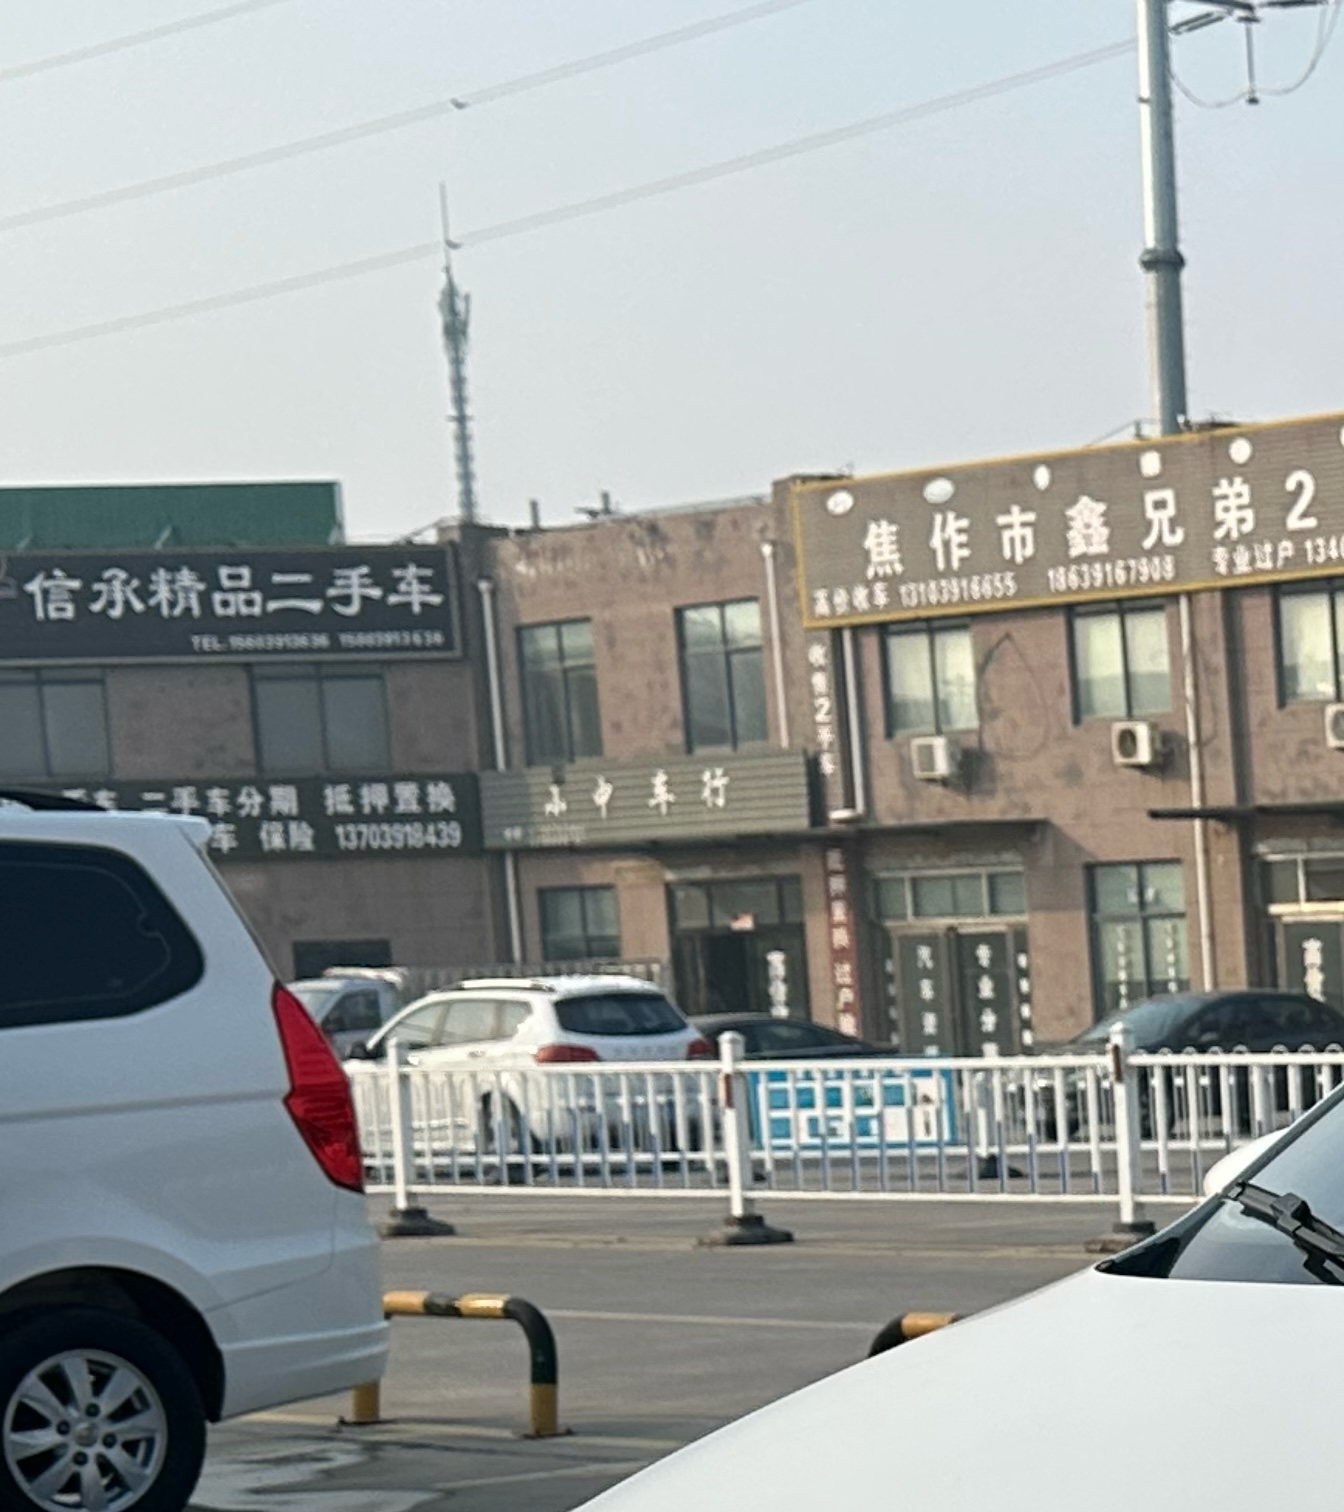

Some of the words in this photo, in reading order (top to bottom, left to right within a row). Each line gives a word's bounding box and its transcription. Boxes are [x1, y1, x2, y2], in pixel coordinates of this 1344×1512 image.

[23, 563, 445, 621] 信承精品二手车
[324, 781, 456, 815] 抵押置换
